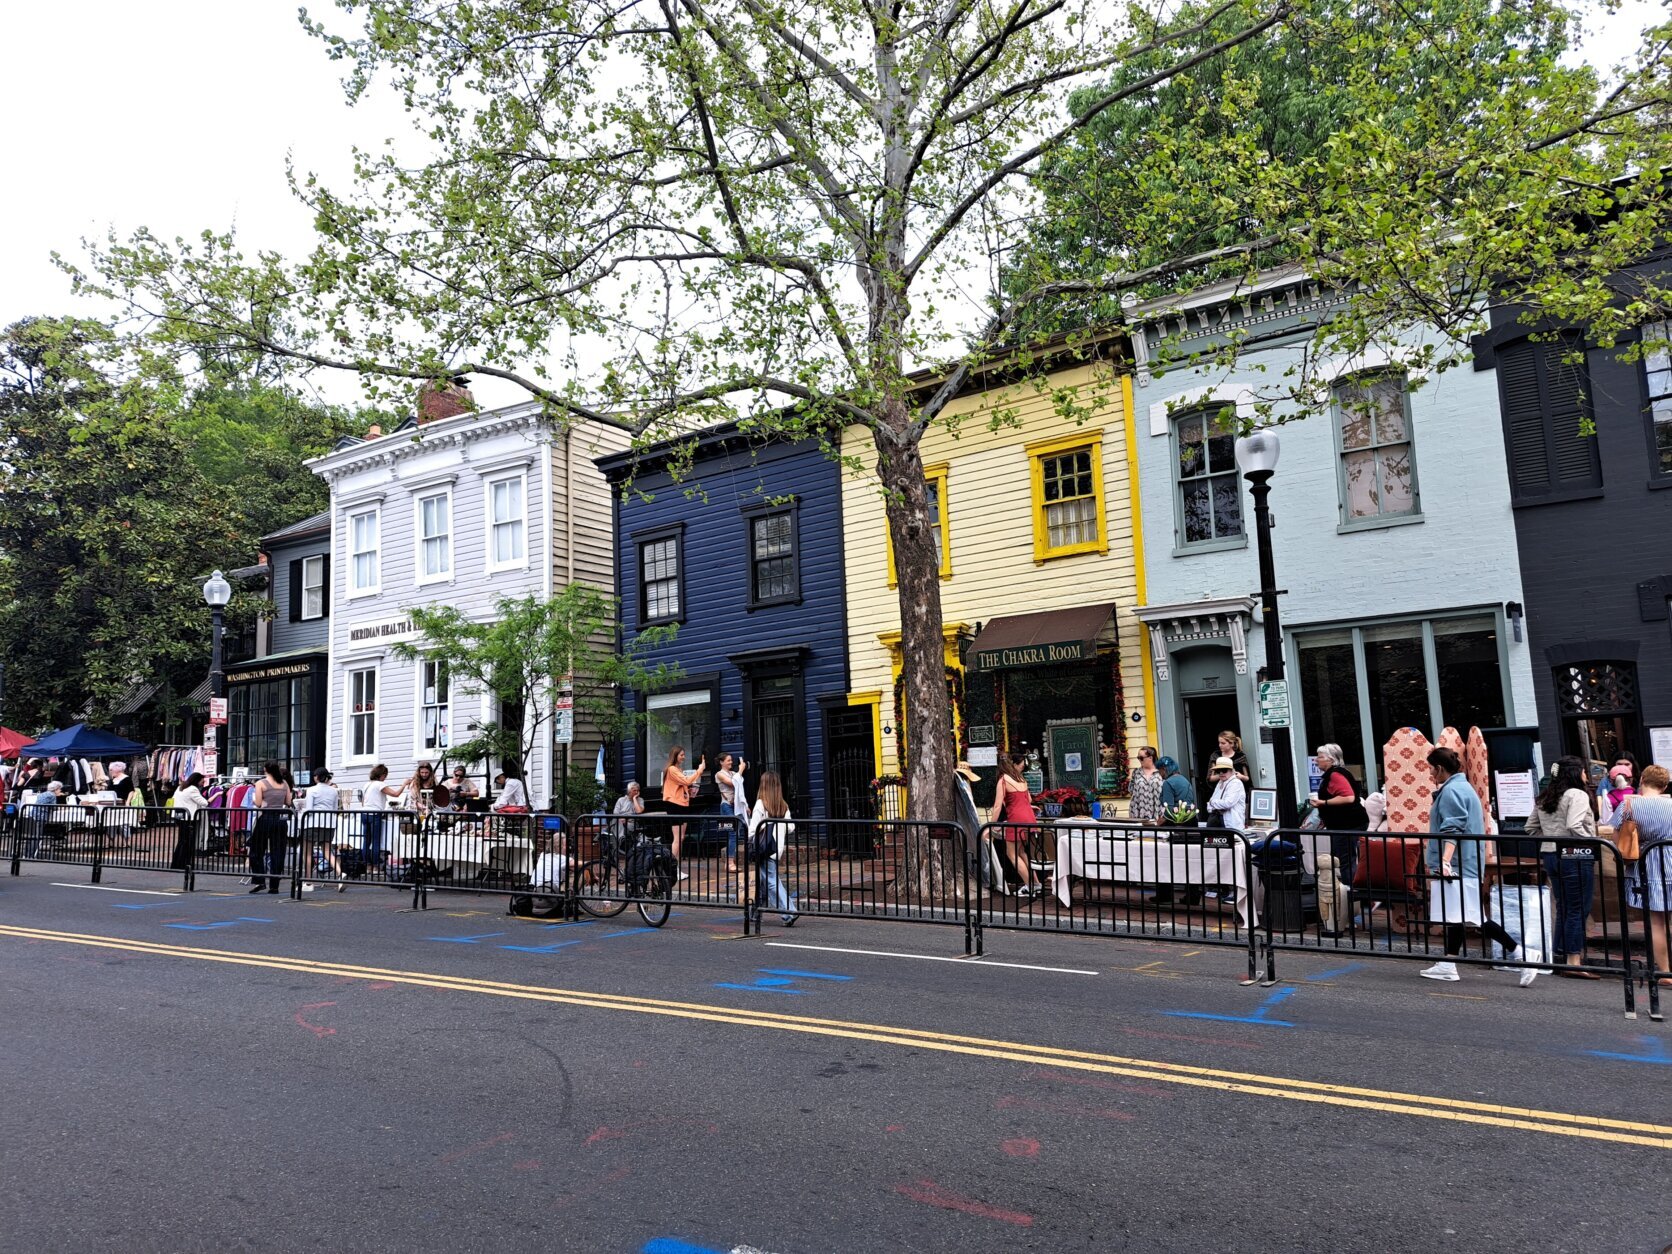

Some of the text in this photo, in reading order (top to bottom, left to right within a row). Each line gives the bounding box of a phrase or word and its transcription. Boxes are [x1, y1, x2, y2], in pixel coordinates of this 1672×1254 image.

[350, 626, 380, 641] MERIDIAN
[381, 622, 406, 636] HEALTH
[979, 644, 1081, 668] THE CHAKRA ROOM
[227, 663, 310, 682] WASHINGTON PRINTMAKERS
[972, 730, 992, 740] OPEN
